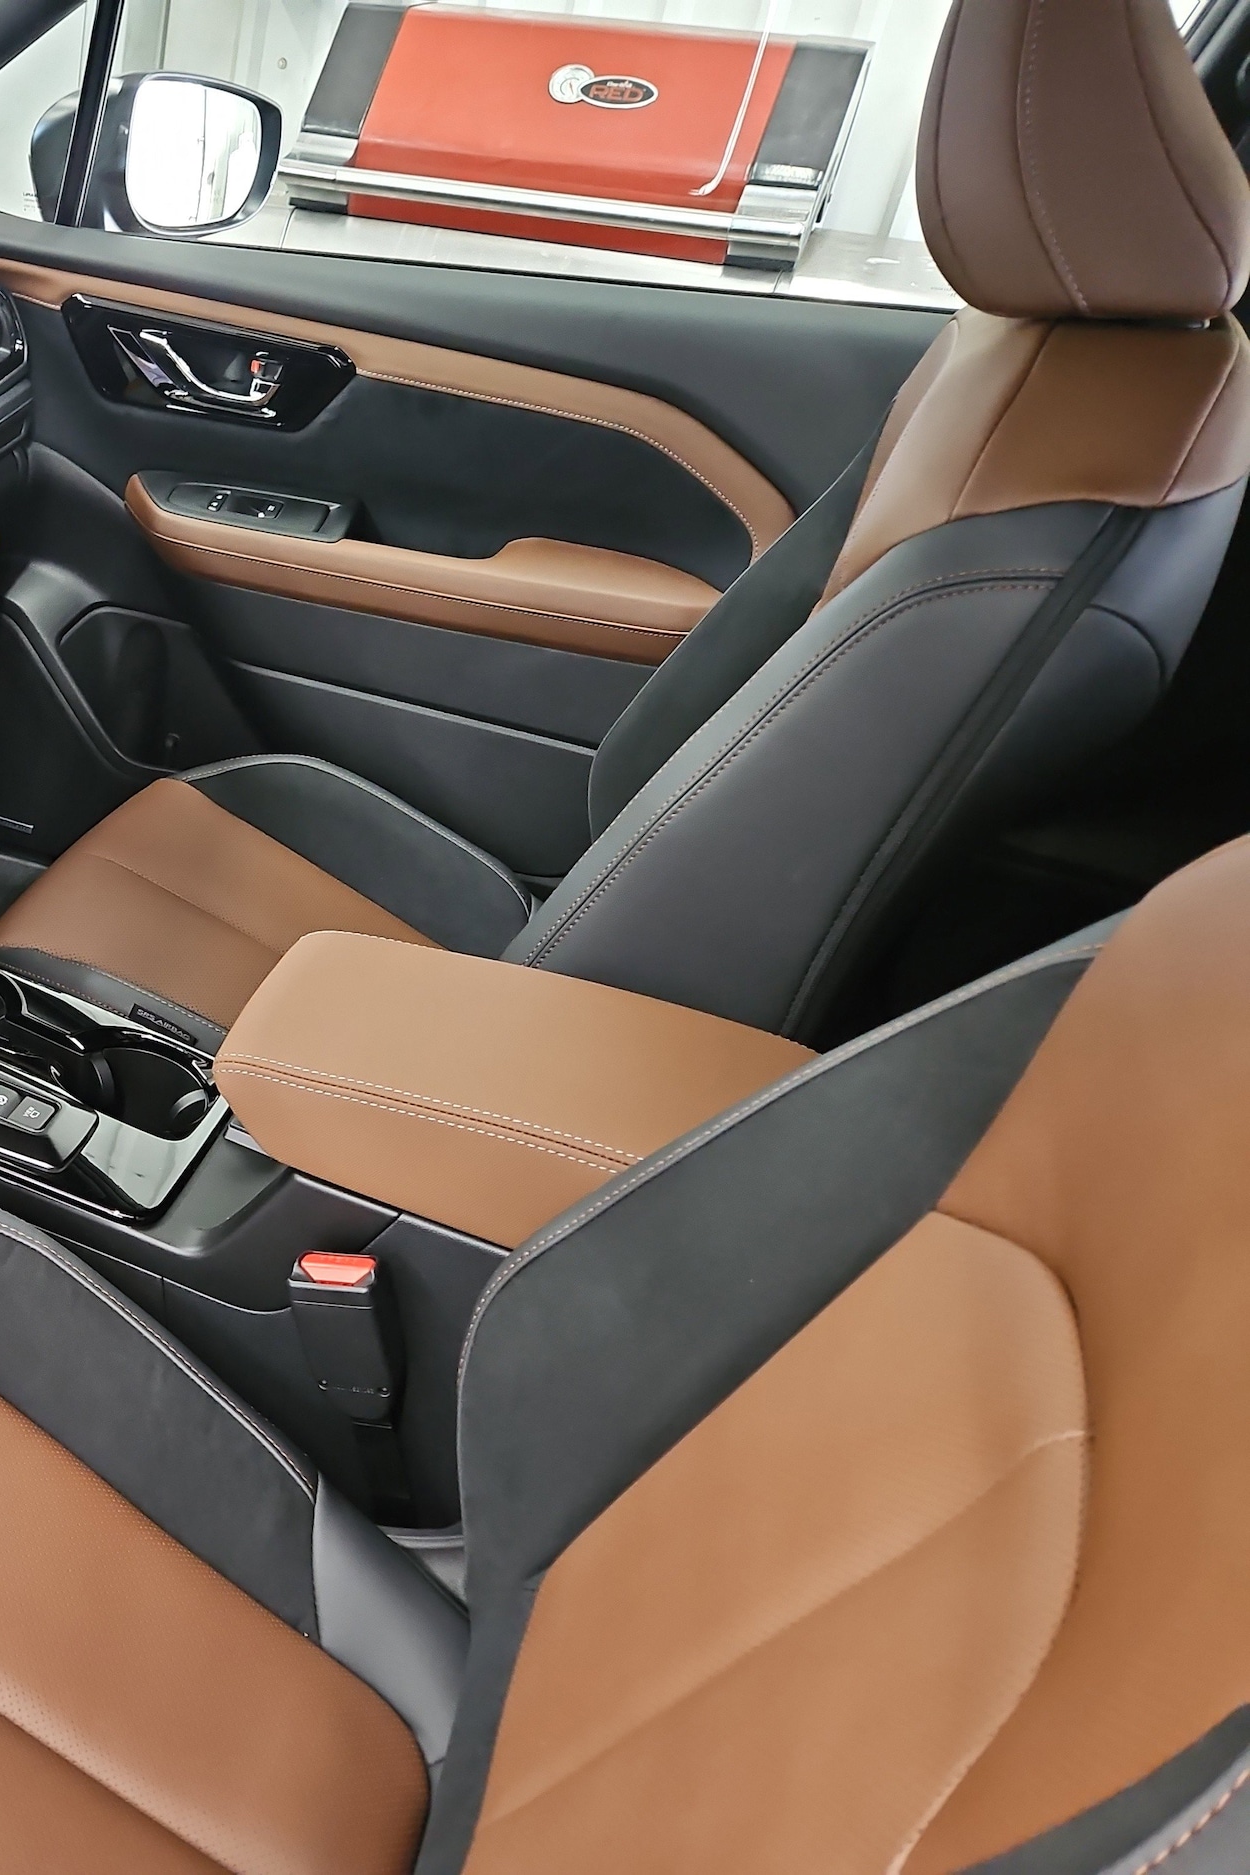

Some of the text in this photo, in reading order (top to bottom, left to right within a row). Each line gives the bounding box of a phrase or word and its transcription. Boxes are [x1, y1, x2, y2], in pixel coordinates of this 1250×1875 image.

[589, 84, 644, 102] RED
[136, 1008, 191, 1041] SRS AIRBAG
